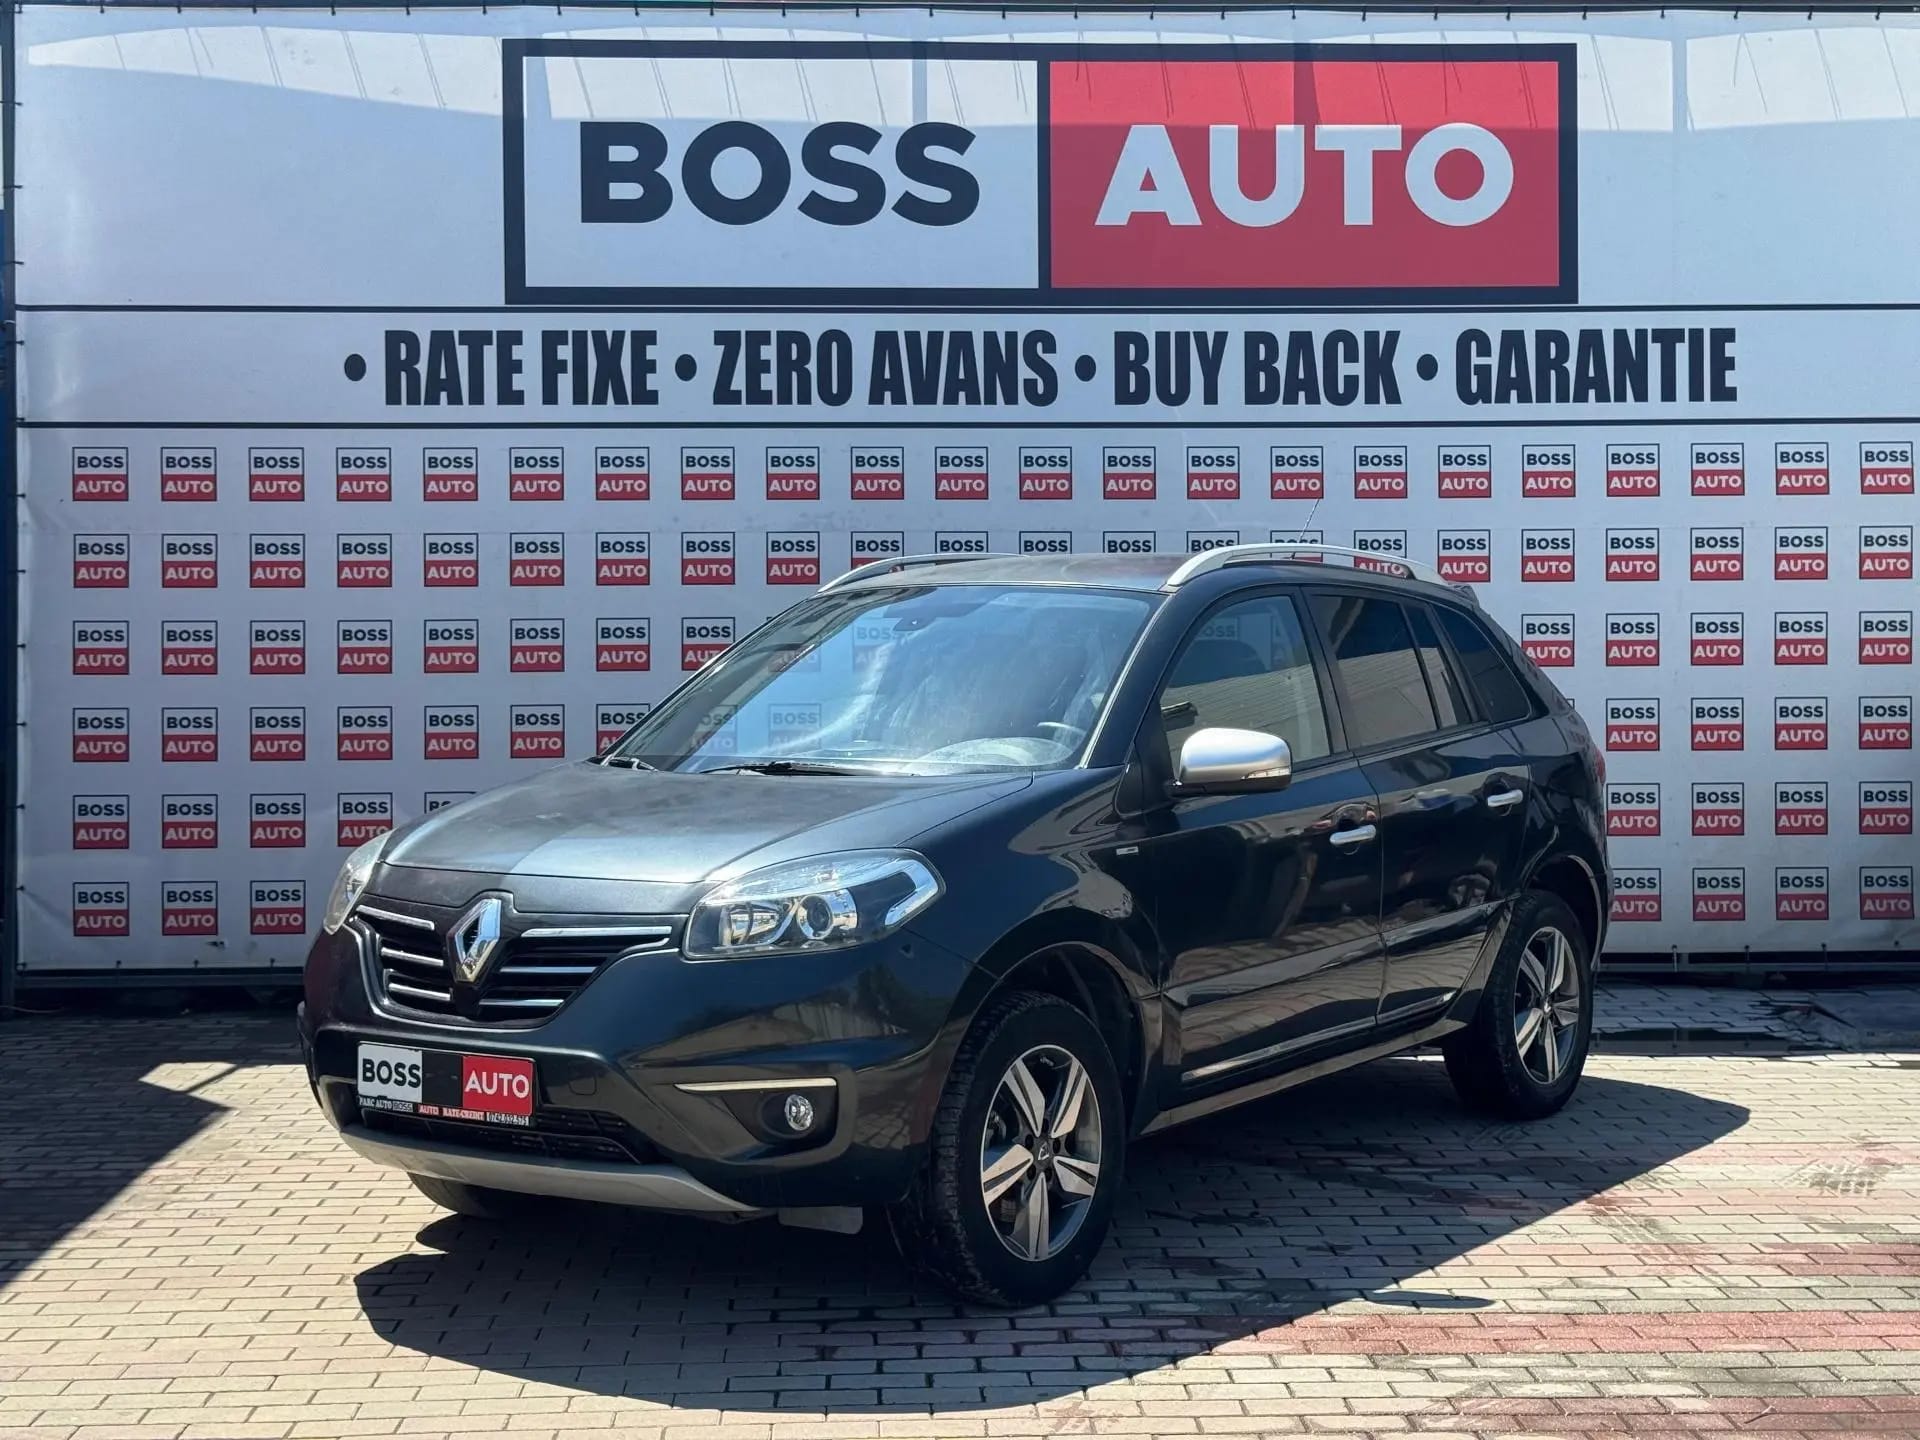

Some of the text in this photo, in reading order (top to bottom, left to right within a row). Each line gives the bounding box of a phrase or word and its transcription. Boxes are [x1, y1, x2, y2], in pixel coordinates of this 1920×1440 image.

[581, 121, 1515, 227] BOSS AUTO
[384, 327, 1738, 407] RATE FIXE ZERO AVANS BUY BACK GARANTIE
[77, 456, 124, 468] BOSS
[166, 456, 212, 469] BOSS
[341, 456, 387, 469] BOSS
[428, 456, 474, 469] BOSS
[514, 456, 560, 468] BOSS
[686, 455, 731, 468] BOSS
[771, 455, 816, 468] BOSS
[855, 455, 900, 468] BOSS
[1024, 455, 1068, 467] BOSS
[1107, 455, 1152, 467] BOSS
[1191, 455, 1235, 467] BOSS
[1359, 454, 1403, 467] BOSS
[1443, 454, 1487, 466] BOSS
[1527, 453, 1571, 465] BOSS
[1695, 452, 1740, 464] BOSS
[1780, 451, 1825, 463] BOSS
[1864, 450, 1909, 462] BOSS
[76, 480, 125, 493] AUTO
[340, 480, 388, 493] AUTO
[426, 480, 475, 493] AUTO
[513, 480, 561, 493] AUTO
[684, 479, 732, 492] AUTO
[769, 479, 817, 492] AUTO
[854, 479, 901, 492] AUTO
[1022, 479, 1070, 491] AUTO
[1106, 479, 1153, 491] AUTO
[1190, 479, 1237, 491] AUTO
[1357, 478, 1404, 491] AUTO
[1441, 477, 1488, 490] AUTO
[1525, 477, 1573, 489] AUTO
[1694, 475, 1741, 488] AUTO
[1778, 474, 1826, 487] AUTO
[1863, 474, 1911, 486] AUTO
[164, 481, 214, 493] AUTO
[600, 541, 646, 553] BOSS
[686, 540, 731, 553] BOSS
[771, 540, 816, 552] BOSS
[855, 540, 900, 552] BOSS
[940, 540, 984, 552] BOSS
[1024, 540, 1068, 552] BOSS
[1107, 540, 1152, 553] BOSS
[1358, 538, 1403, 551] BOSS
[1442, 538, 1486, 550] BOSS
[1610, 537, 1655, 549] BOSS
[1695, 536, 1740, 548] BOSS
[1779, 535, 1824, 548] BOSS
[1864, 534, 1908, 547] BOSS
[78, 543, 125, 555] BOSS
[166, 543, 213, 555] BOSS
[254, 543, 301, 555] BOSS
[342, 542, 388, 555] BOSS
[514, 541, 560, 554] BOSS
[684, 564, 732, 577] AUTO
[769, 564, 817, 576] AUTO
[1441, 562, 1488, 574] AUTO
[1609, 560, 1656, 573] AUTO
[1693, 560, 1741, 572] AUTO
[1778, 559, 1825, 572] AUTO
[1862, 558, 1910, 571] AUTO
[77, 567, 127, 580] AUTO
[165, 567, 215, 580] AUTO
[253, 567, 302, 579] AUTO
[340, 567, 389, 579] AUTO
[513, 565, 562, 578] AUTO
[599, 565, 647, 578] AUTO
[686, 626, 731, 638] BOSS
[1526, 623, 1570, 635] BOSS
[1610, 622, 1655, 634] BOSS
[1779, 620, 1824, 633] BOSS
[1864, 620, 1908, 632] BOSS
[77, 630, 124, 642] BOSS
[166, 629, 213, 642] BOSS
[342, 629, 388, 641] BOSS
[429, 628, 474, 641] BOSS
[515, 627, 560, 640] BOSS
[601, 627, 646, 639] BOSS
[1526, 646, 1572, 659] AUTO
[1609, 645, 1657, 658] AUTO
[1778, 644, 1825, 657] AUTO
[1862, 643, 1910, 656] AUTO
[76, 654, 126, 667] AUTO
[165, 654, 215, 666] AUTO
[341, 653, 389, 666] AUTO
[427, 652, 476, 665] AUTO
[513, 651, 562, 664] AUTO
[599, 651, 647, 663] AUTO
[685, 650, 721, 663] AUT
[772, 711, 819, 724] BOSS
[1610, 707, 1656, 719] BOSS
[1695, 706, 1740, 719] BOSS
[1779, 705, 1823, 718] BOSS
[1863, 705, 1908, 717] BOSS
[78, 717, 125, 729] BOSS
[167, 716, 213, 729] BOSS
[255, 716, 301, 728] BOSS
[429, 714, 475, 727] BOSS
[515, 713, 560, 726] BOSS
[1609, 730, 1657, 743] AUTO
[1694, 730, 1741, 743] AUTO
[1778, 729, 1825, 742] AUTO
[1862, 729, 1909, 741] AUTO
[76, 741, 126, 754] AUTO
[165, 740, 215, 753] AUTO
[253, 740, 303, 753] AUTO
[428, 738, 476, 751] AUTO
[513, 737, 562, 750] AUTO
[1611, 792, 1656, 804] BOSS
[1696, 791, 1740, 804] BOSS
[1864, 790, 1908, 802] BOSS
[78, 804, 125, 816] BOSS
[167, 803, 213, 816] BOSS
[255, 802, 301, 815] BOSS
[342, 801, 388, 814] BOSS
[1609, 816, 1658, 828] AUTO
[1695, 815, 1741, 828] AUTO
[1862, 814, 1910, 826] AUTO
[76, 828, 126, 841] AUTO
[165, 827, 215, 840] AUTO
[254, 826, 303, 840] AUTO
[1697, 876, 1741, 889] BOSS
[1780, 876, 1824, 888] BOSS
[1864, 875, 1909, 888] BOSS
[78, 891, 125, 904] BOSS
[167, 890, 213, 903] BOSS
[255, 889, 301, 902] BOSS
[1611, 900, 1658, 913] AUTO
[1696, 900, 1742, 913] AUTO
[1778, 900, 1826, 912] AUTO
[1862, 899, 1911, 911] AUTO
[76, 916, 126, 928] AUTO
[165, 914, 215, 927] AUTO
[253, 913, 303, 926] AUTO
[362, 1058, 530, 1099] BOSS AUTO
[375, 1099, 392, 1109] AUTO
